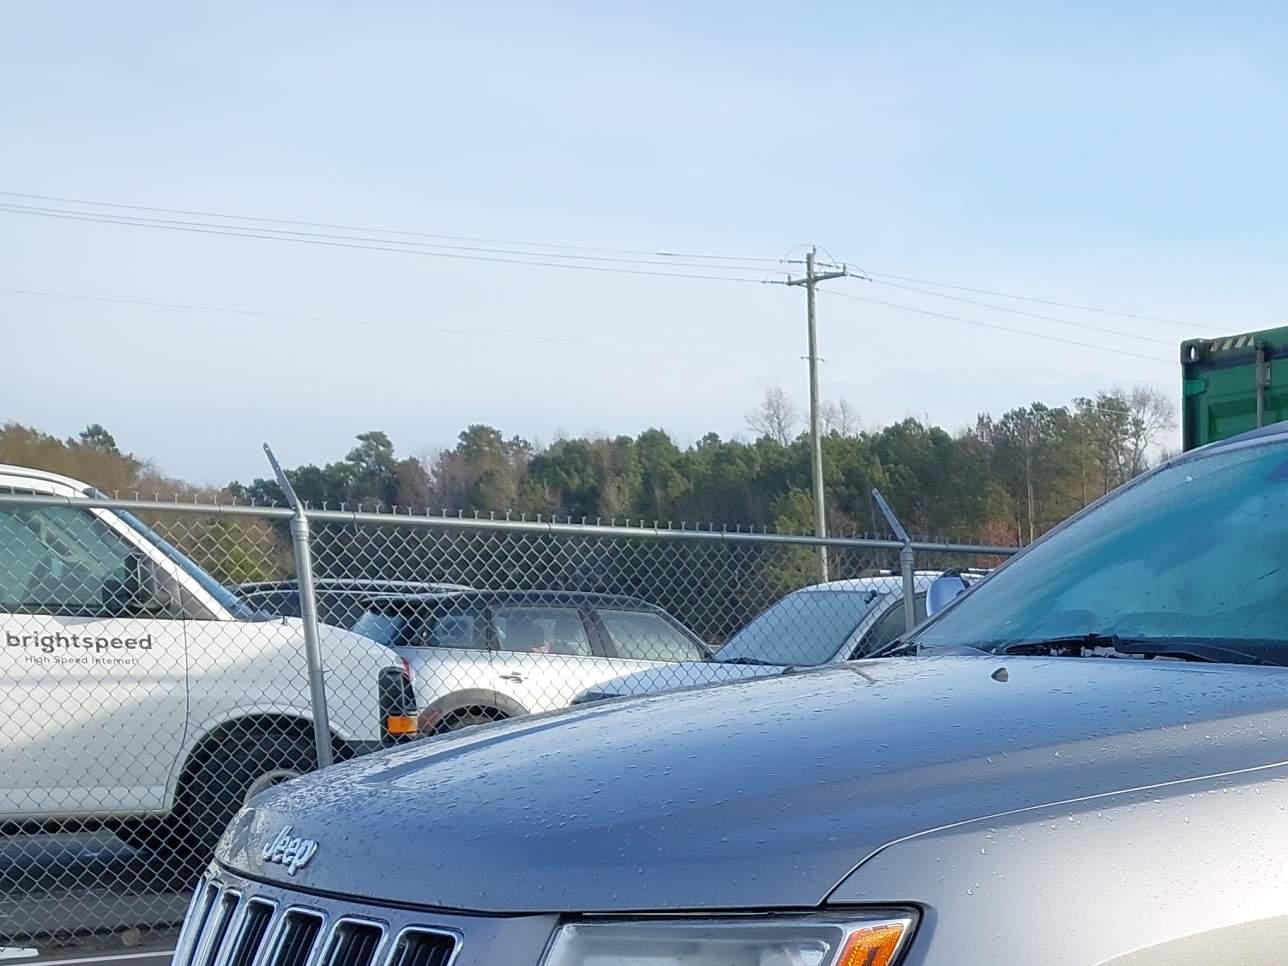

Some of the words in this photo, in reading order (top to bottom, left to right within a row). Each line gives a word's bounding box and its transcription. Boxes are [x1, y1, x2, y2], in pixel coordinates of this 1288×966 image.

[5, 630, 153, 653] brightspeed
[24, 655, 50, 666] High
[54, 655, 88, 665] Speed
[262, 824, 319, 877] Jeep
